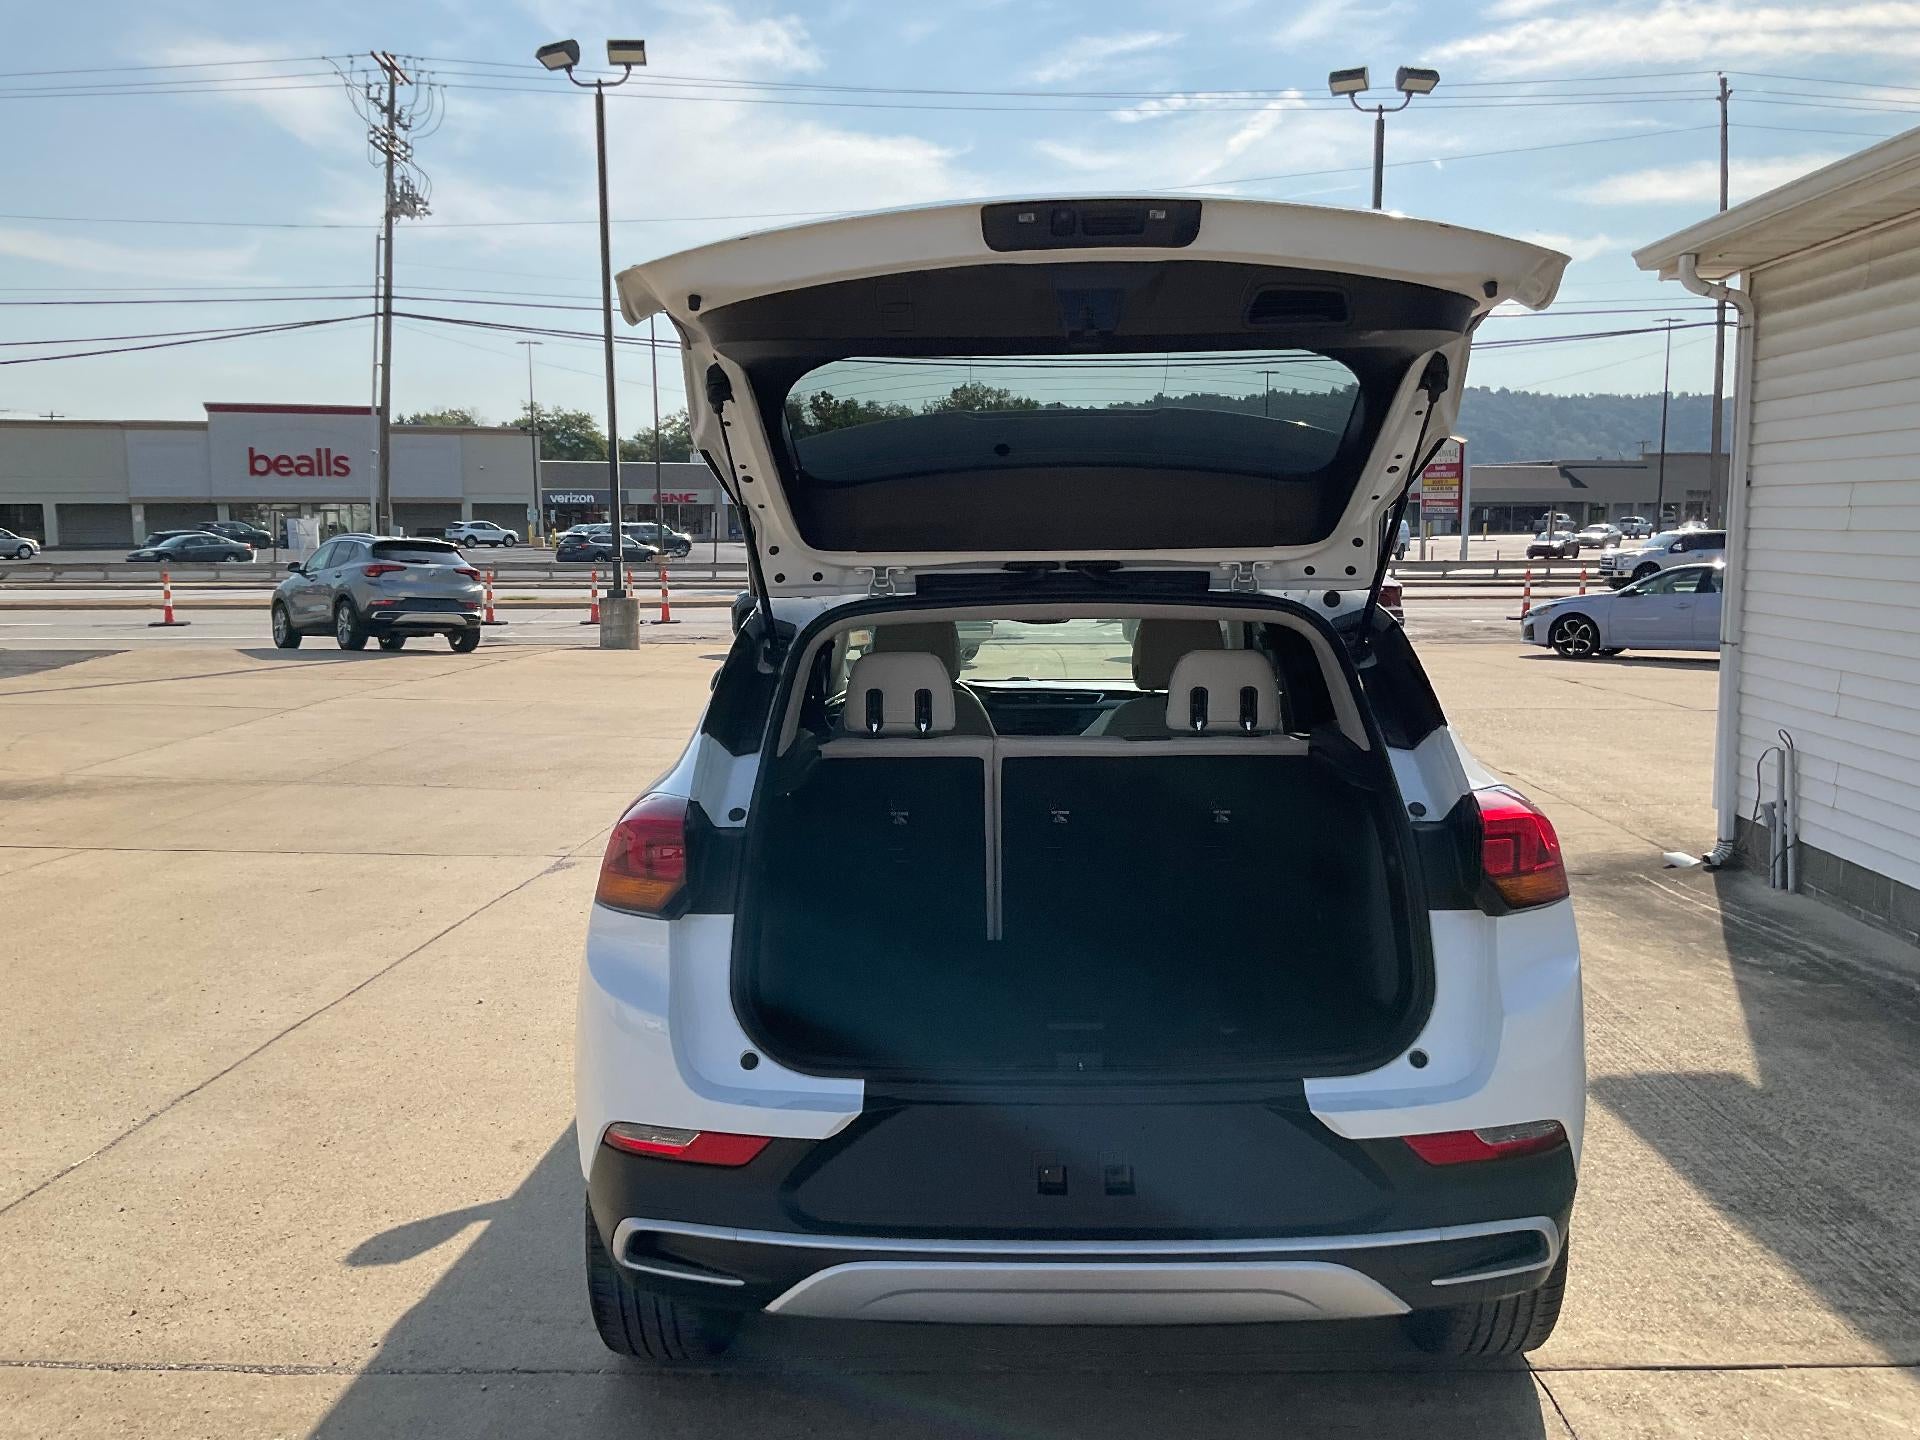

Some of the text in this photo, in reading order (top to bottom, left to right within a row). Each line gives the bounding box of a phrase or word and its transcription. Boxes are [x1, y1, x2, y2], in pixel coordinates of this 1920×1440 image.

[248, 447, 351, 477] bealls
[550, 492, 595, 503] verizon
[653, 493, 698, 503] GNC
